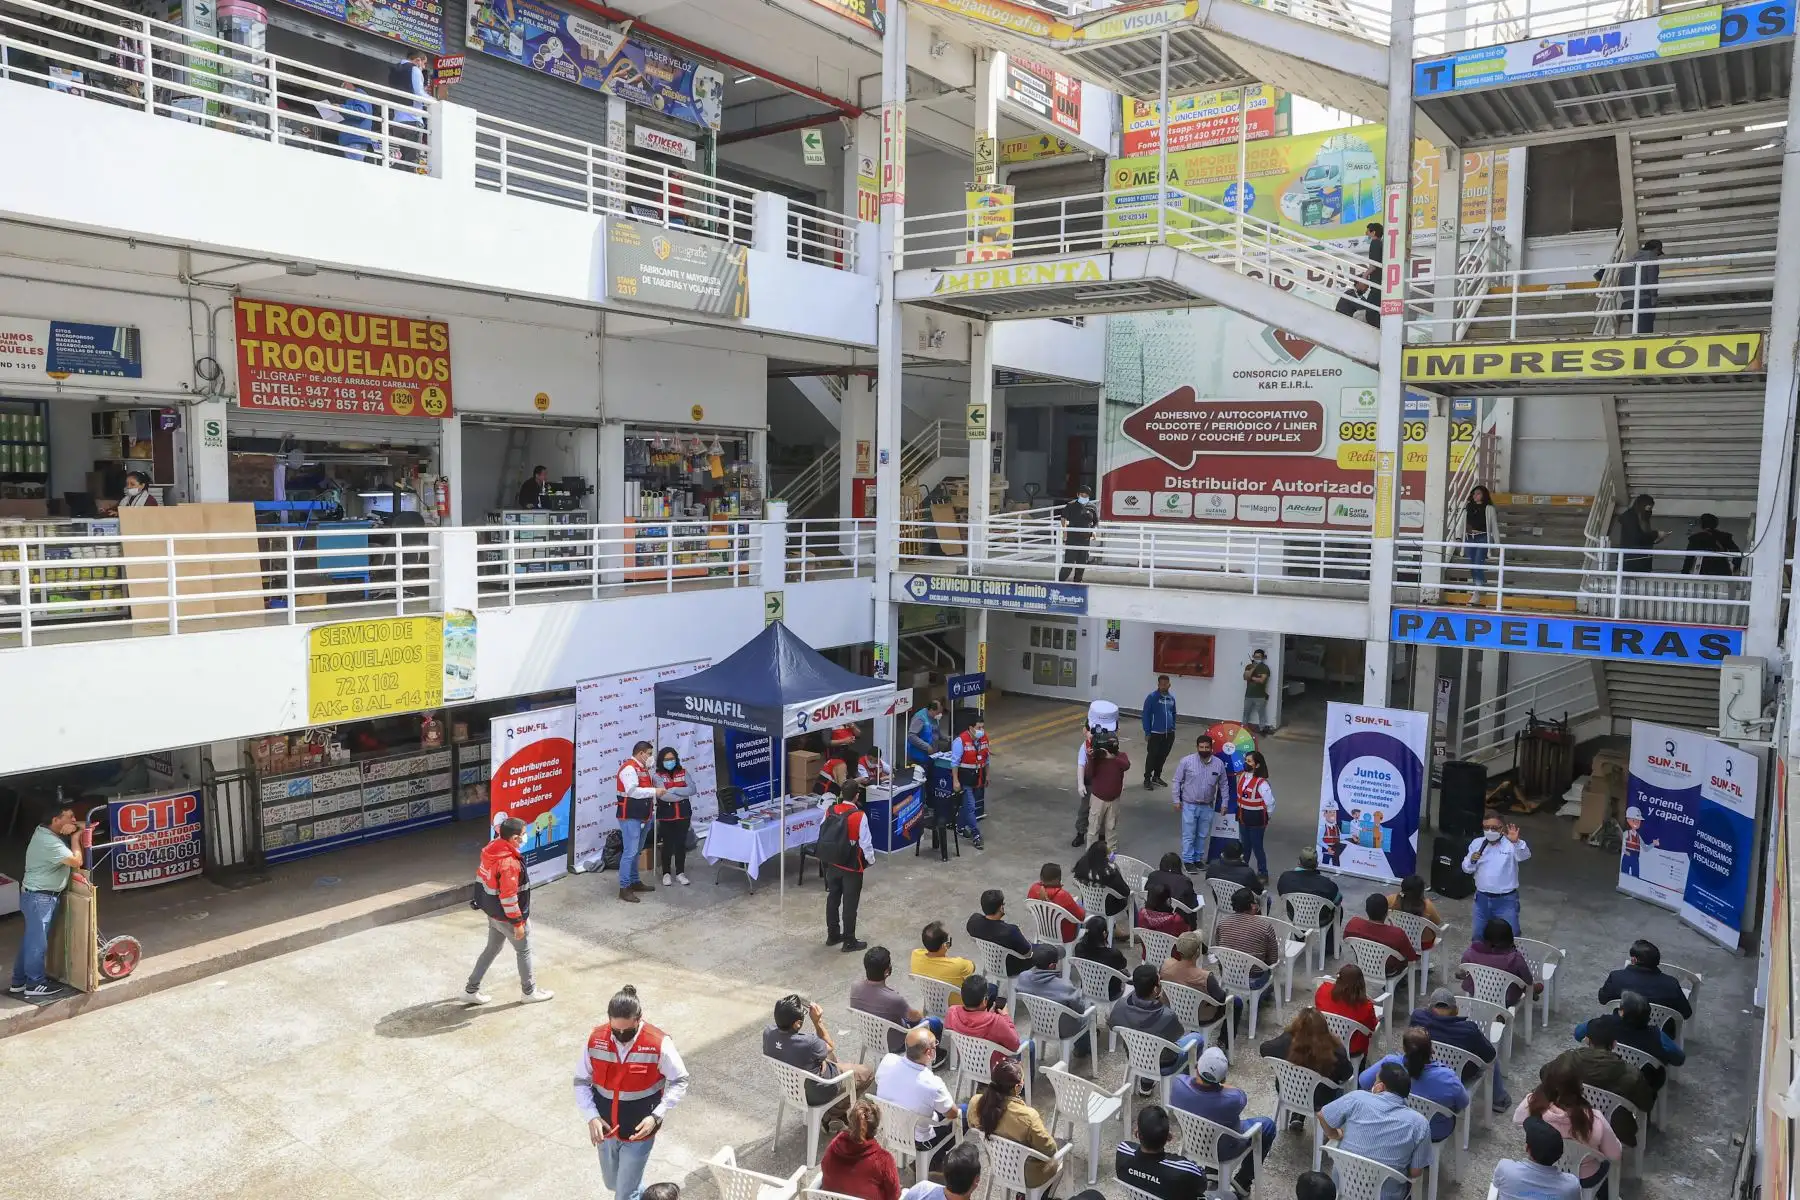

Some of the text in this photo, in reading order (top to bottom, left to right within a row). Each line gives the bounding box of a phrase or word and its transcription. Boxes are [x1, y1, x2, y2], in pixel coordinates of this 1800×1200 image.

[1660, 24, 1717, 40] HOT STAMPING
[645, 48, 668, 63] LASER
[670, 58, 692, 72] VELOZ
[1058, 96, 1079, 120] UNI
[1175, 108, 1220, 122] UNICENTRO
[1249, 98, 1267, 109] 3349
[648, 134, 683, 150] STIKERS
[858, 190, 878, 222] CTP
[1386, 193, 1400, 294] CTP
[640, 264, 680, 279] FABRICANTE
[686, 273, 722, 286] MAYORISTA
[617, 284, 637, 296] 2319
[642, 276, 721, 296] DE TARJETAS Y VOLANTES
[238, 301, 448, 352] TROQUELES
[240, 338, 450, 382] TROQUELADOS
[1406, 339, 1750, 377] IMPRESIÓN
[322, 374, 343, 384] JOSÉ
[344, 378, 380, 388] ARRASCO
[382, 380, 420, 390] CARBAJAL
[1232, 368, 1342, 378] CONSORCIO PAPELERO
[252, 382, 382, 400] ENTEL: 947 168 142
[429, 388, 437, 398] B
[1258, 381, 1314, 390] K&R E.I.R.L.
[252, 394, 384, 412] CLARO: 997 857 874
[392, 392, 412, 405] 1320
[425, 400, 443, 409] K-3
[1154, 410, 1308, 420] ADHESIVO AUTOCOPIATIVO
[206, 421, 220, 436] S
[1145, 420, 1318, 430] FOLDCOTE PERIÓDICO LINER
[1158, 432, 1301, 442] BOND COUCHÉ DUPLEX
[1164, 476, 1374, 494] Distribuidor Autorizado
[931, 577, 1047, 598] SERVICIO DE CORTE Jaimito
[320, 622, 412, 646] SERVICIO DE
[1398, 614, 1733, 661] PAPELERAS
[310, 645, 422, 674] TROQUELADOS
[336, 672, 399, 697] 72 X 102
[963, 684, 980, 693] LIMA
[352, 698, 363, 712] 8
[367, 695, 392, 710] AL
[685, 696, 746, 718] SUNAFIL
[666, 710, 698, 720] Superintendencia
[700, 715, 717, 724] Nacional
[723, 720, 750, 730] Fiscalización
[750, 724, 767, 732] Laboral
[736, 737, 769, 750] PROMOVEMOS
[736, 746, 770, 760] SUPERVISAMOS
[737, 756, 770, 768] FISCALIZAMOS
[510, 758, 560, 776] Contribuyendo
[1354, 766, 1392, 781] Juntos
[510, 778, 516, 787] la
[517, 768, 562, 786] formalización
[522, 784, 542, 794] de los
[1353, 792, 1393, 802] enfermedades
[1380, 788, 1400, 797] trabajo
[510, 791, 553, 810] trabajadores
[1350, 798, 1390, 809] ocupacionales
[1638, 790, 1684, 812] Te orienta
[118, 796, 196, 834] CTP
[1648, 808, 1695, 826] y capacita
[170, 822, 200, 836] TODAS
[127, 834, 192, 852] LAS MEDIDAS
[1696, 829, 1732, 852] PROMOVEMOS
[116, 840, 200, 870] 988 446 691
[1694, 840, 1732, 866] SUPERVISAMOS
[118, 858, 200, 883] STAND 1237 S
[1693, 852, 1730, 877] FISCALIZAMOS
[1128, 1168, 1160, 1184] CRISTAL
